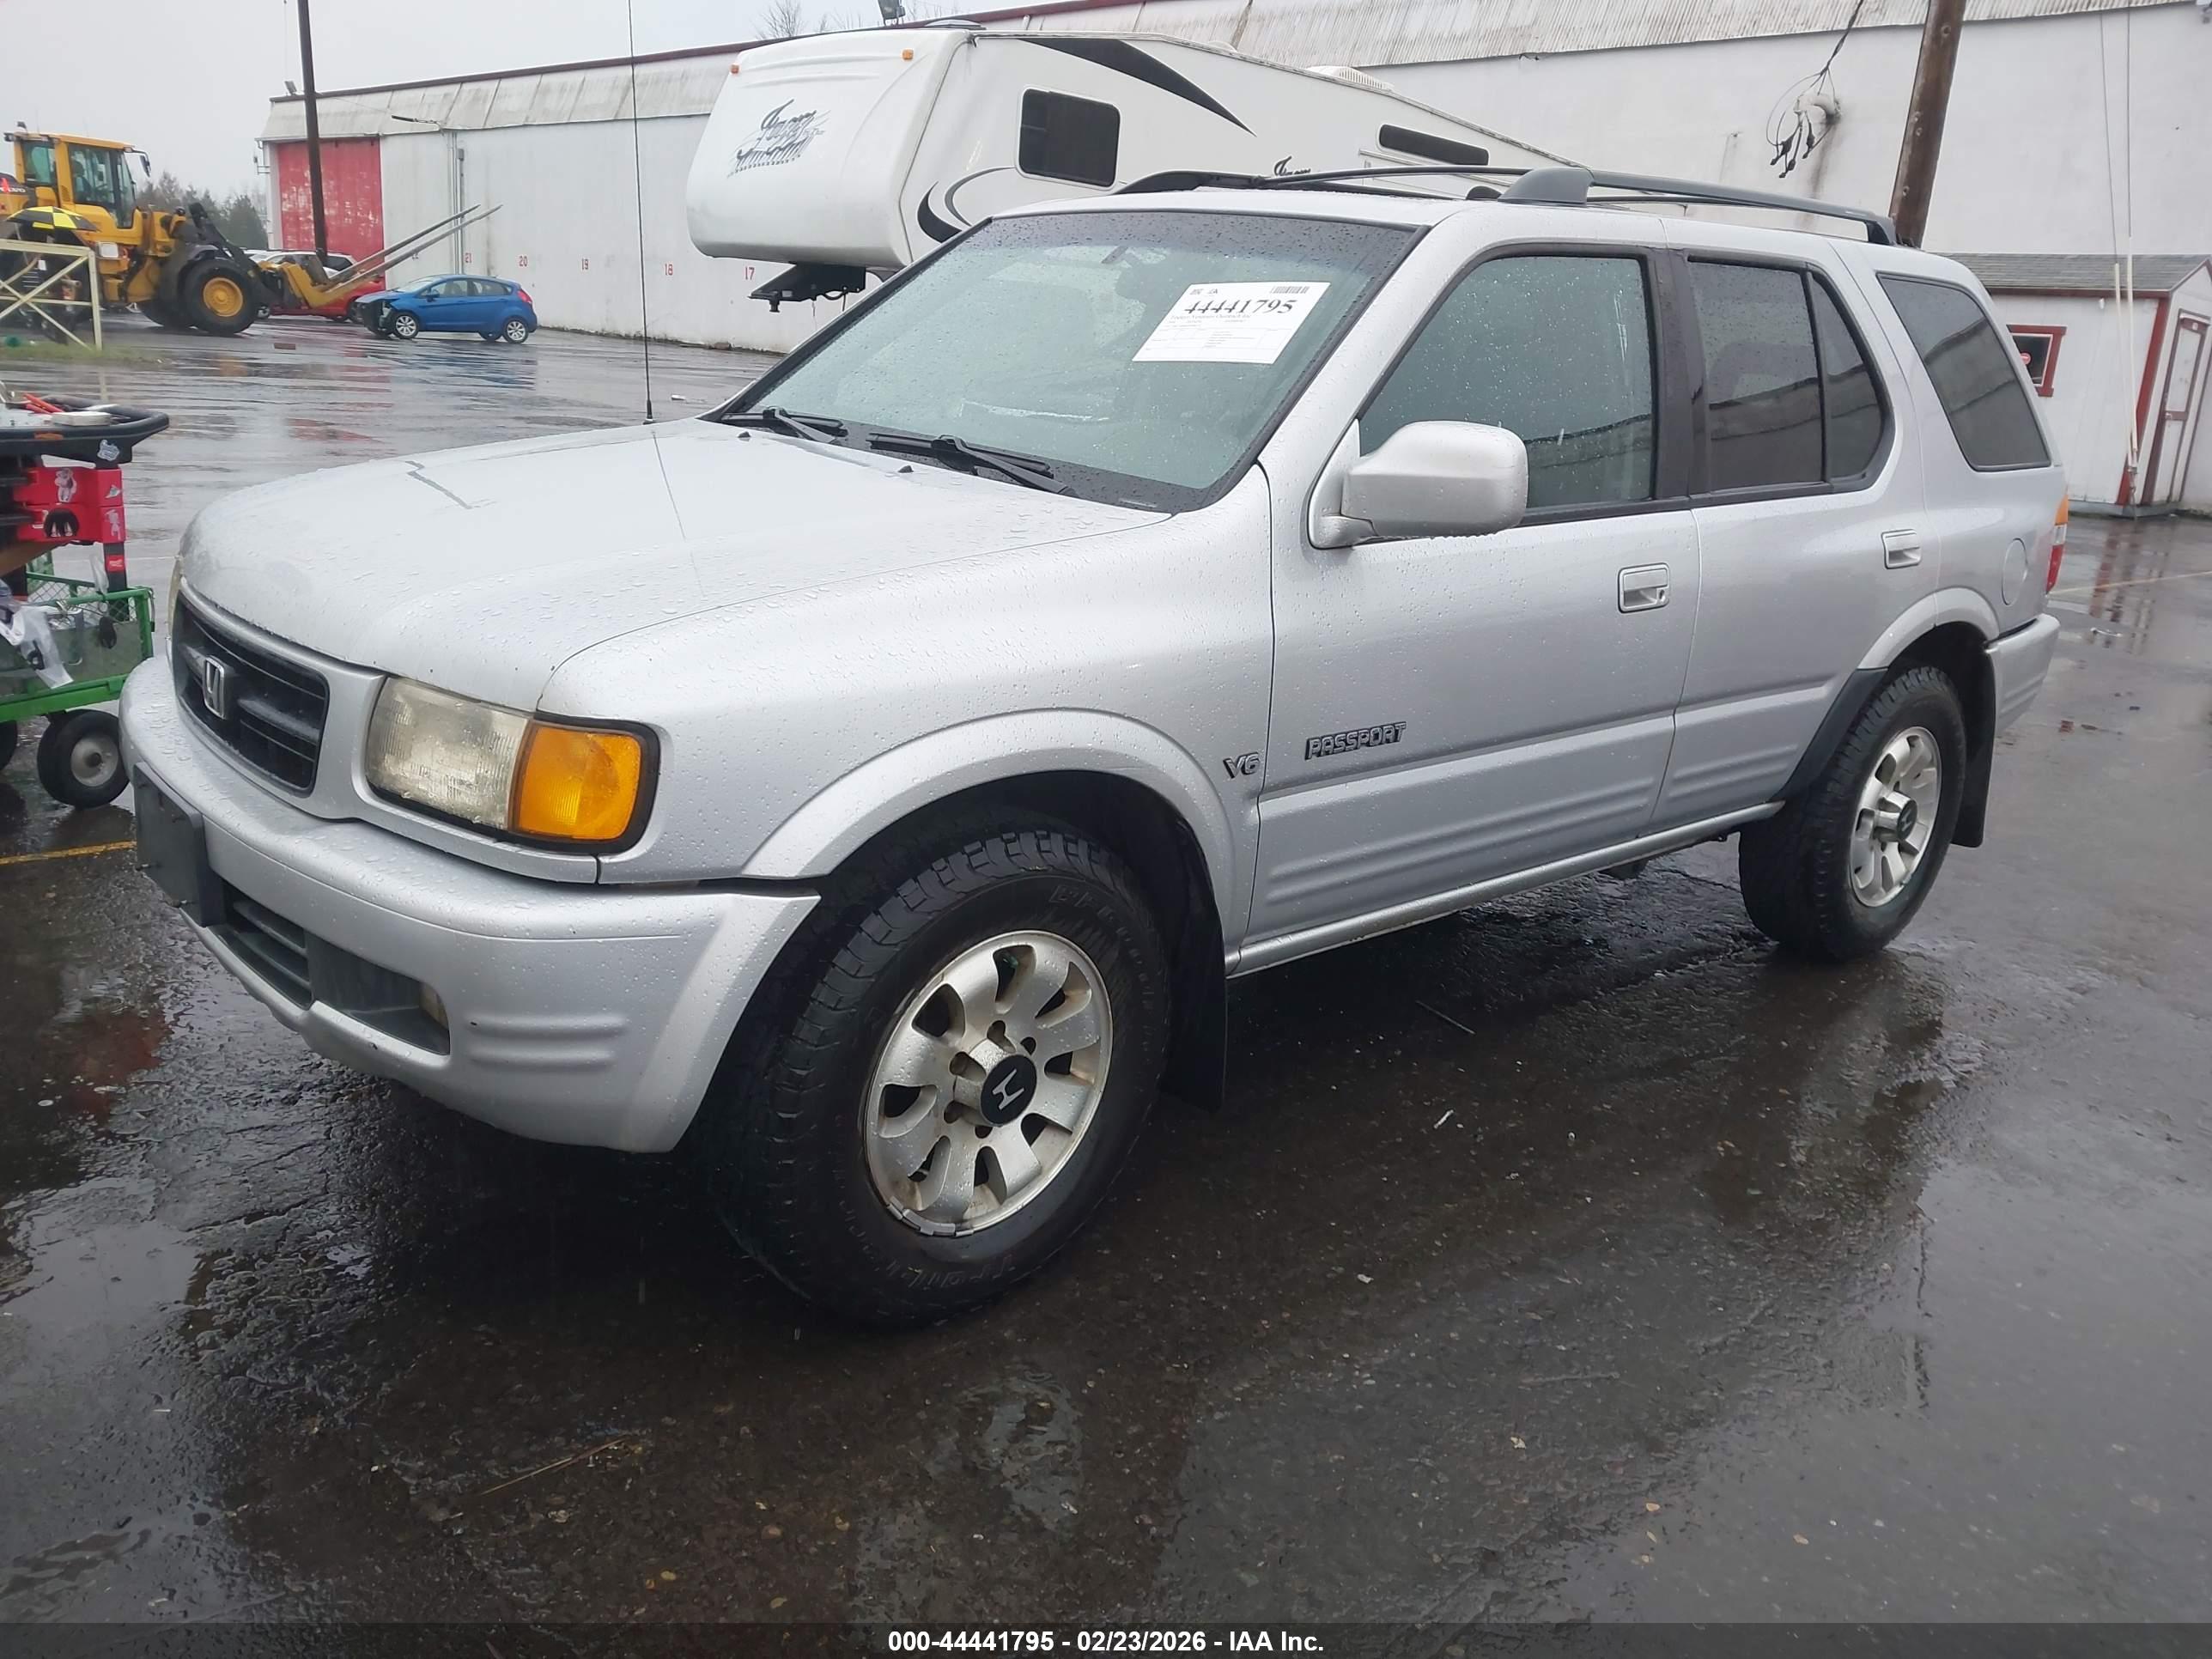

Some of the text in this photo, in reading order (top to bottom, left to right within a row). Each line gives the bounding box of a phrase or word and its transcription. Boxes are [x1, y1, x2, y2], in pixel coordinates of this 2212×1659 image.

[465, 252, 472, 263] 21
[519, 255, 528, 267] 20
[581, 258, 589, 270] 19
[665, 264, 673, 276] 18
[744, 267, 755, 280] 17
[1184, 299, 1298, 314] 44441795
[1304, 721, 1407, 760] PASSPORT
[1223, 751, 1260, 779] V6
